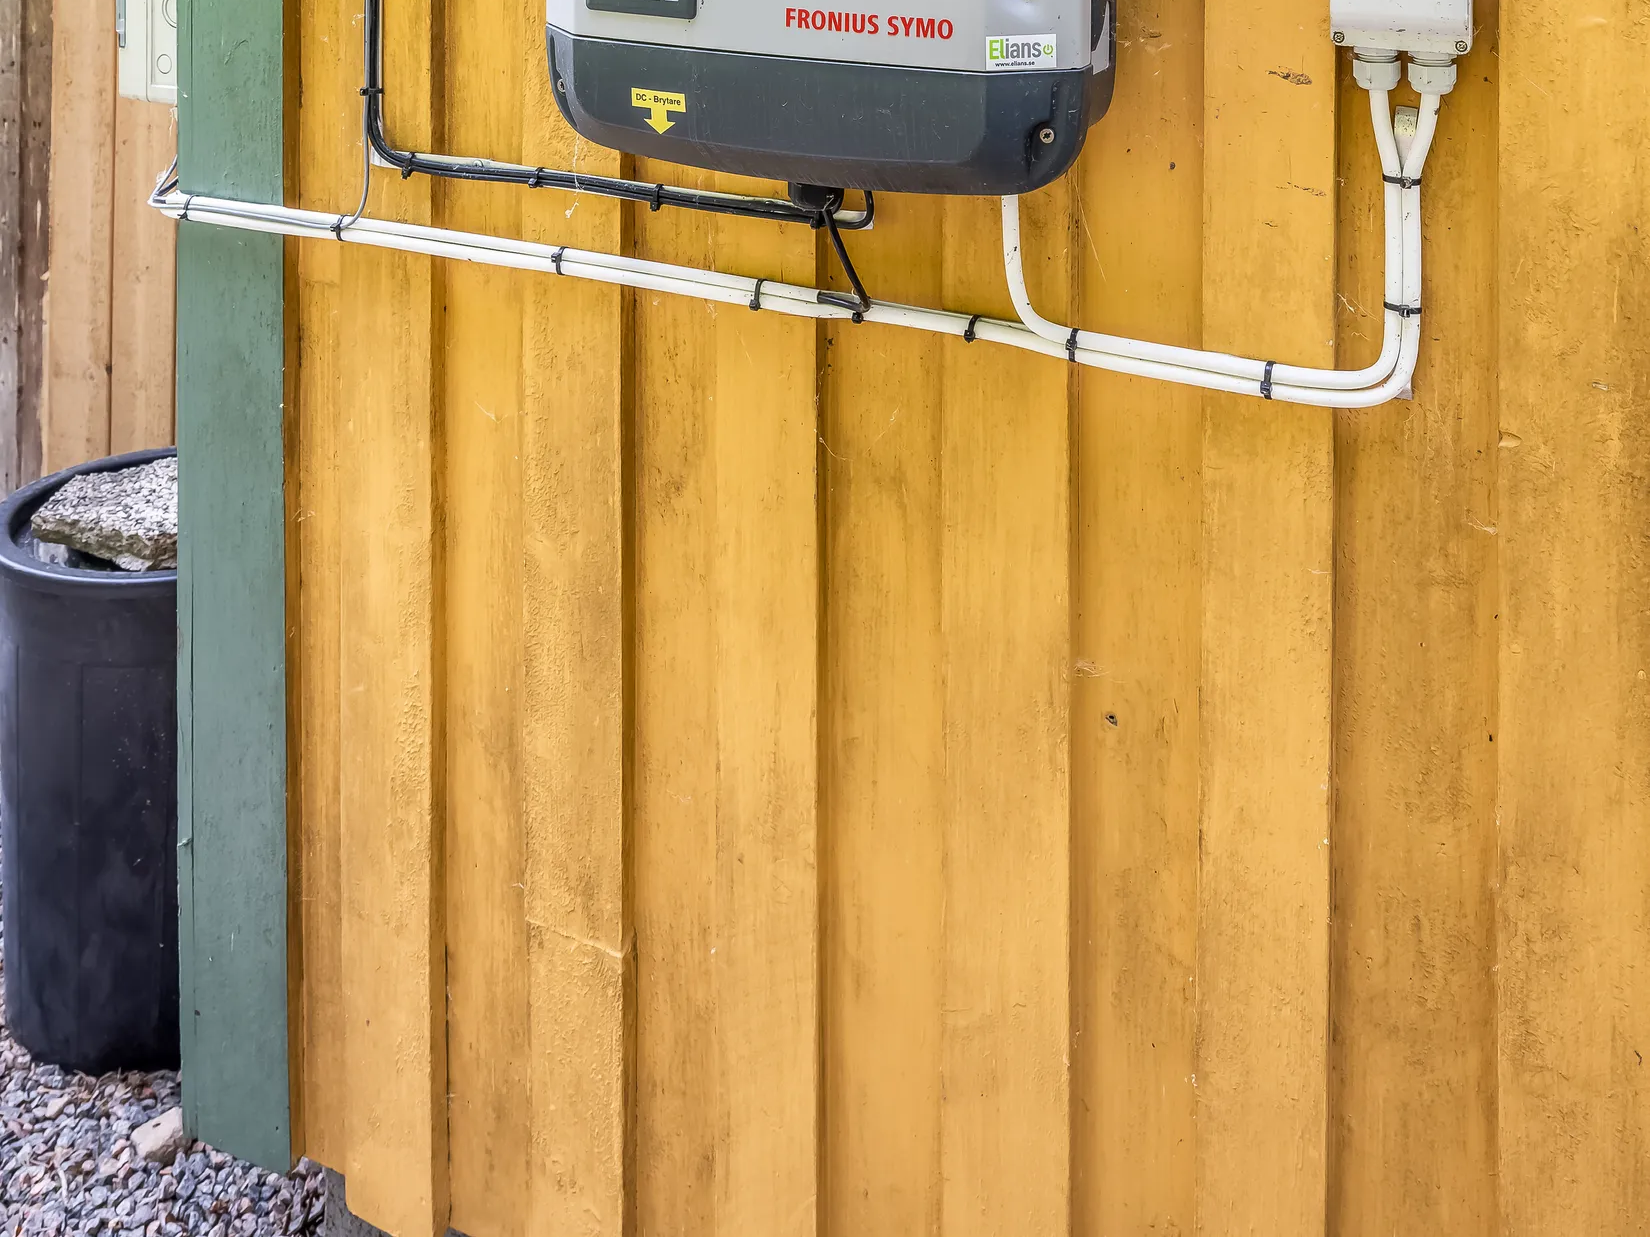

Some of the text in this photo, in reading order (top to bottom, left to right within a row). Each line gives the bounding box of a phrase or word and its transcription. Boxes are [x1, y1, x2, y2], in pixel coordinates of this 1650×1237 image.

[785, 7, 955, 40] FRONIUS SYMO
[989, 38, 1042, 60] Elians
[636, 93, 647, 102] DC
[654, 95, 681, 105] Brytare
